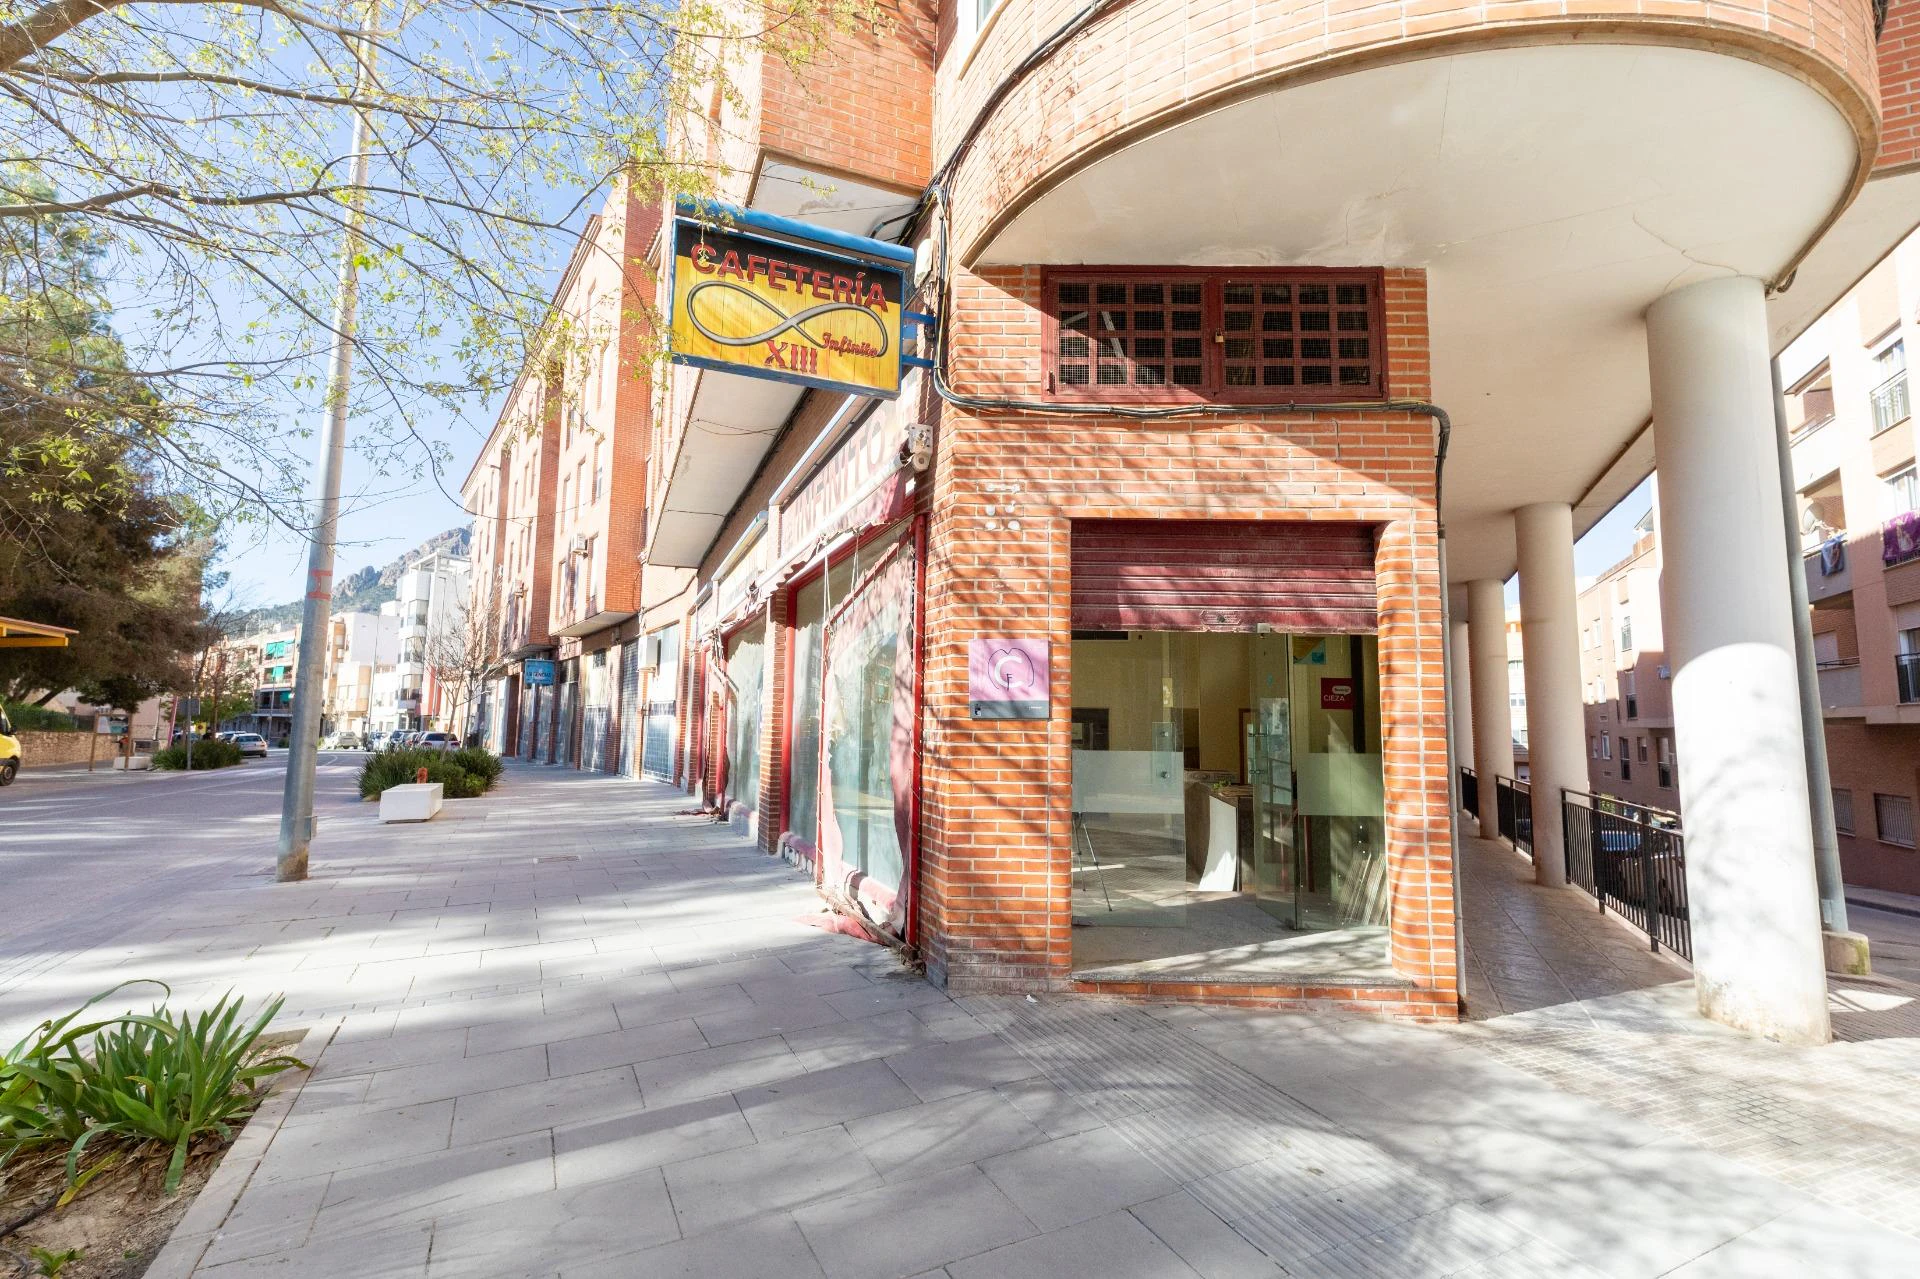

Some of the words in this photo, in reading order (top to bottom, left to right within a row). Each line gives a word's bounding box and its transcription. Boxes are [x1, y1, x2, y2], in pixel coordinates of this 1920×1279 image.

[690, 243, 889, 313] CAFETERÍA
[764, 339, 818, 374] XIII
[1323, 694, 1345, 702] CIEZA
